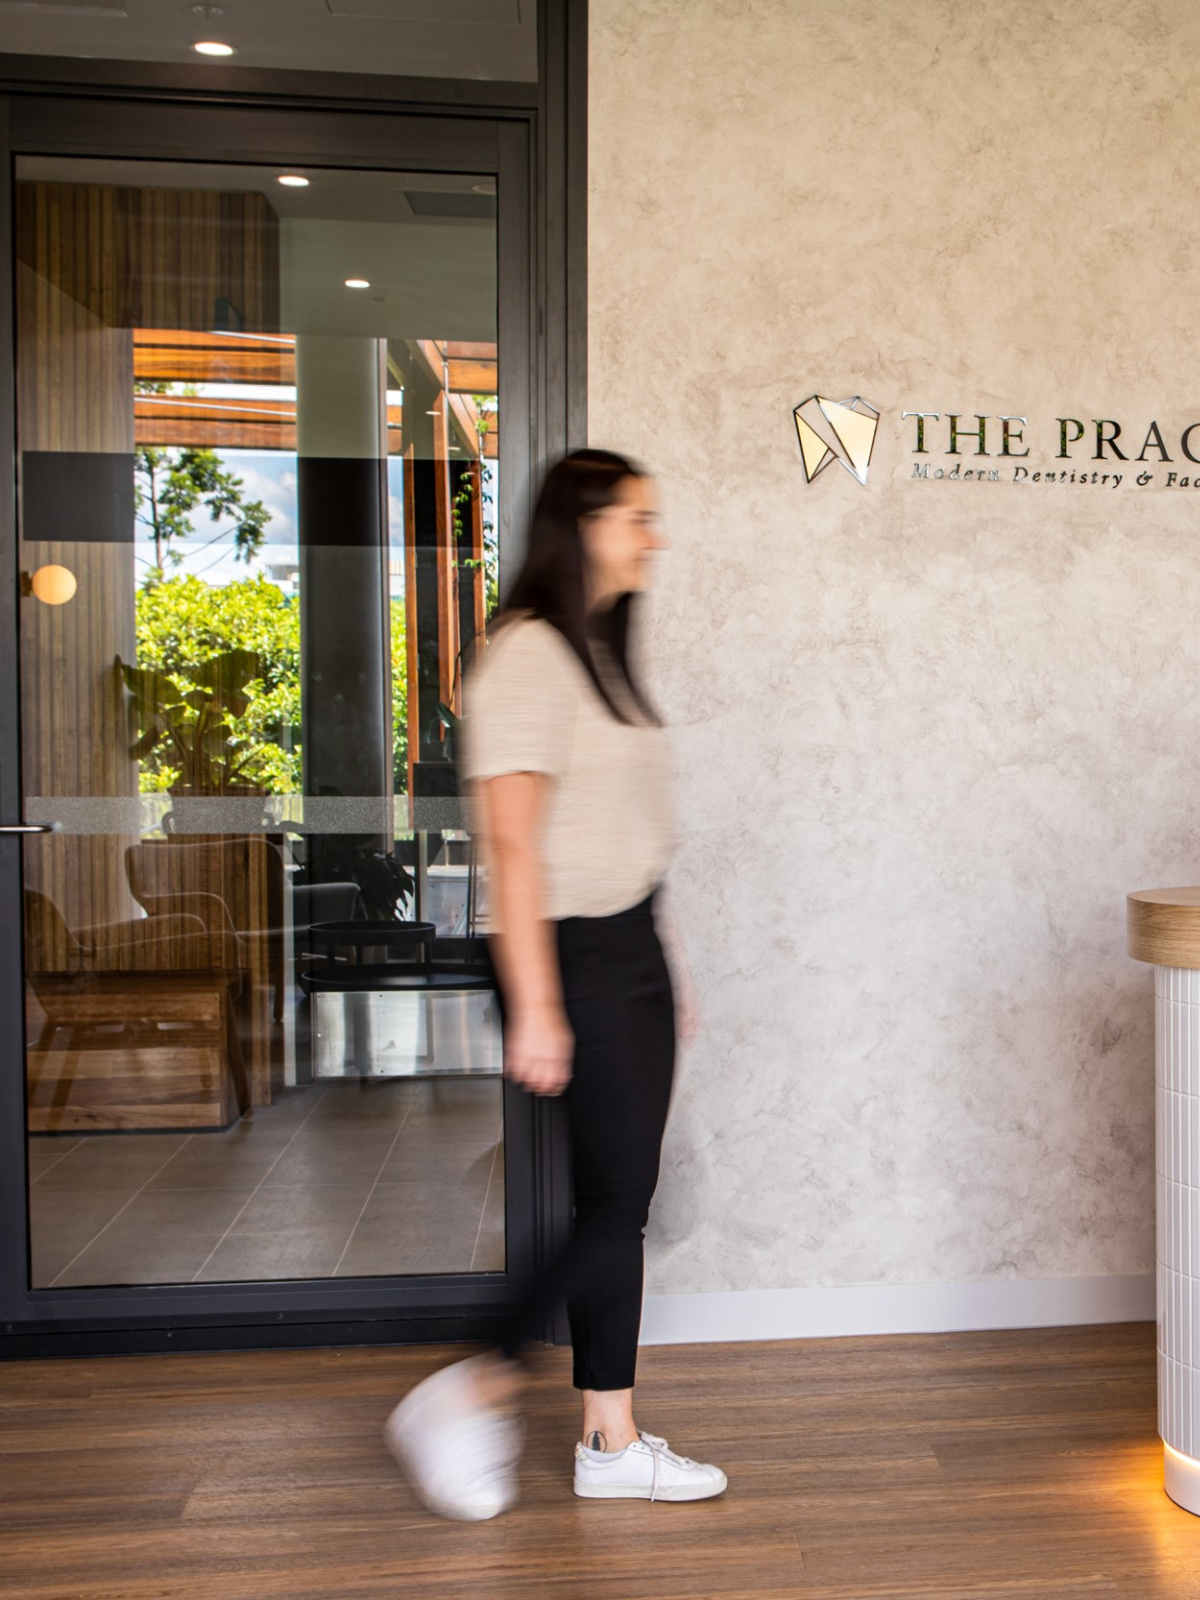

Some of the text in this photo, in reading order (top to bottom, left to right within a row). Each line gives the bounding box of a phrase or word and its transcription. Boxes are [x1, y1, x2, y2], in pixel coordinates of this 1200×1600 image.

[901, 411, 1030, 457] THE
[911, 463, 999, 481] Modern
[1012, 466, 1123, 489] Dentistry
[1136, 470, 1153, 486] &
